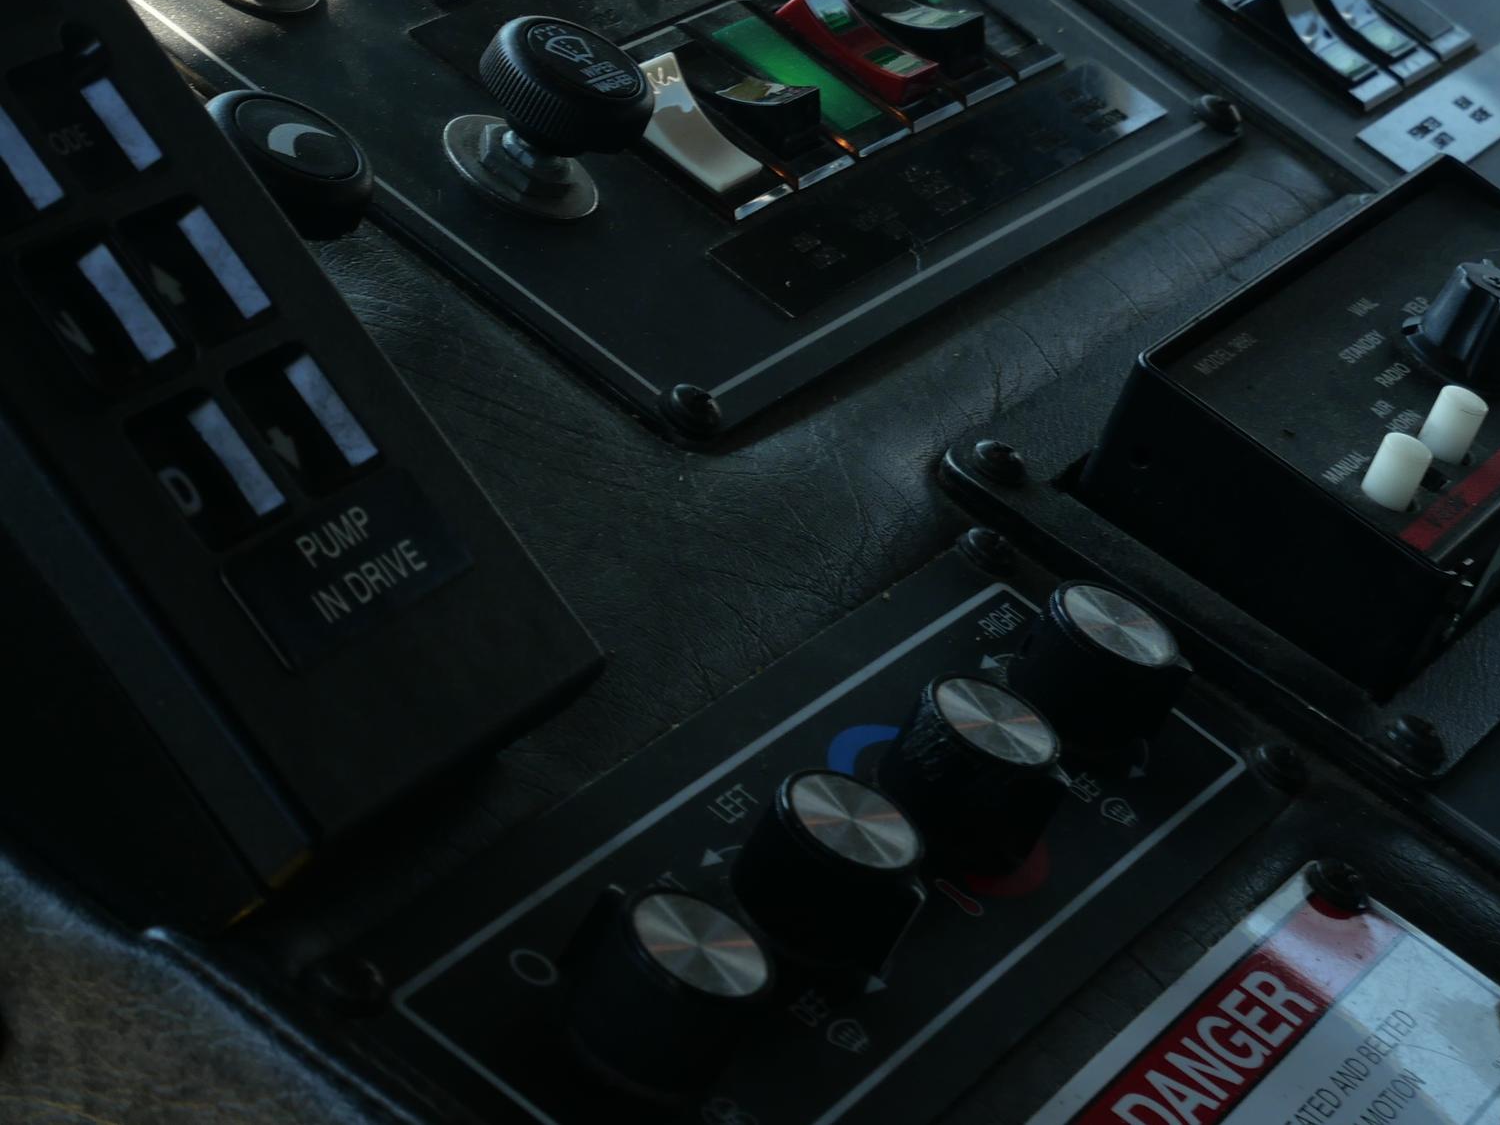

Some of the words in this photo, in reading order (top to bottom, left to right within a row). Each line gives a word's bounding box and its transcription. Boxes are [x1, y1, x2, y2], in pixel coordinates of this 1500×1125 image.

[48, 122, 95, 156] ODE
[1338, 328, 1388, 364] STANDBY
[1373, 362, 1412, 388] RADIO
[1369, 399, 1397, 419] AIR
[1319, 451, 1371, 484] MANUAL
[157, 466, 204, 519] D
[294, 504, 372, 570] PUMP
[310, 583, 345, 625] IN
[344, 539, 429, 608] DRIVE
[977, 602, 1027, 639] RIGHT
[706, 782, 761, 825] LEFT
[1111, 970, 1318, 1125] DANGER
[1329, 1058, 1371, 1096] AND
[1356, 1009, 1418, 1065] BELTED
[1359, 1068, 1427, 1125] MOTION
